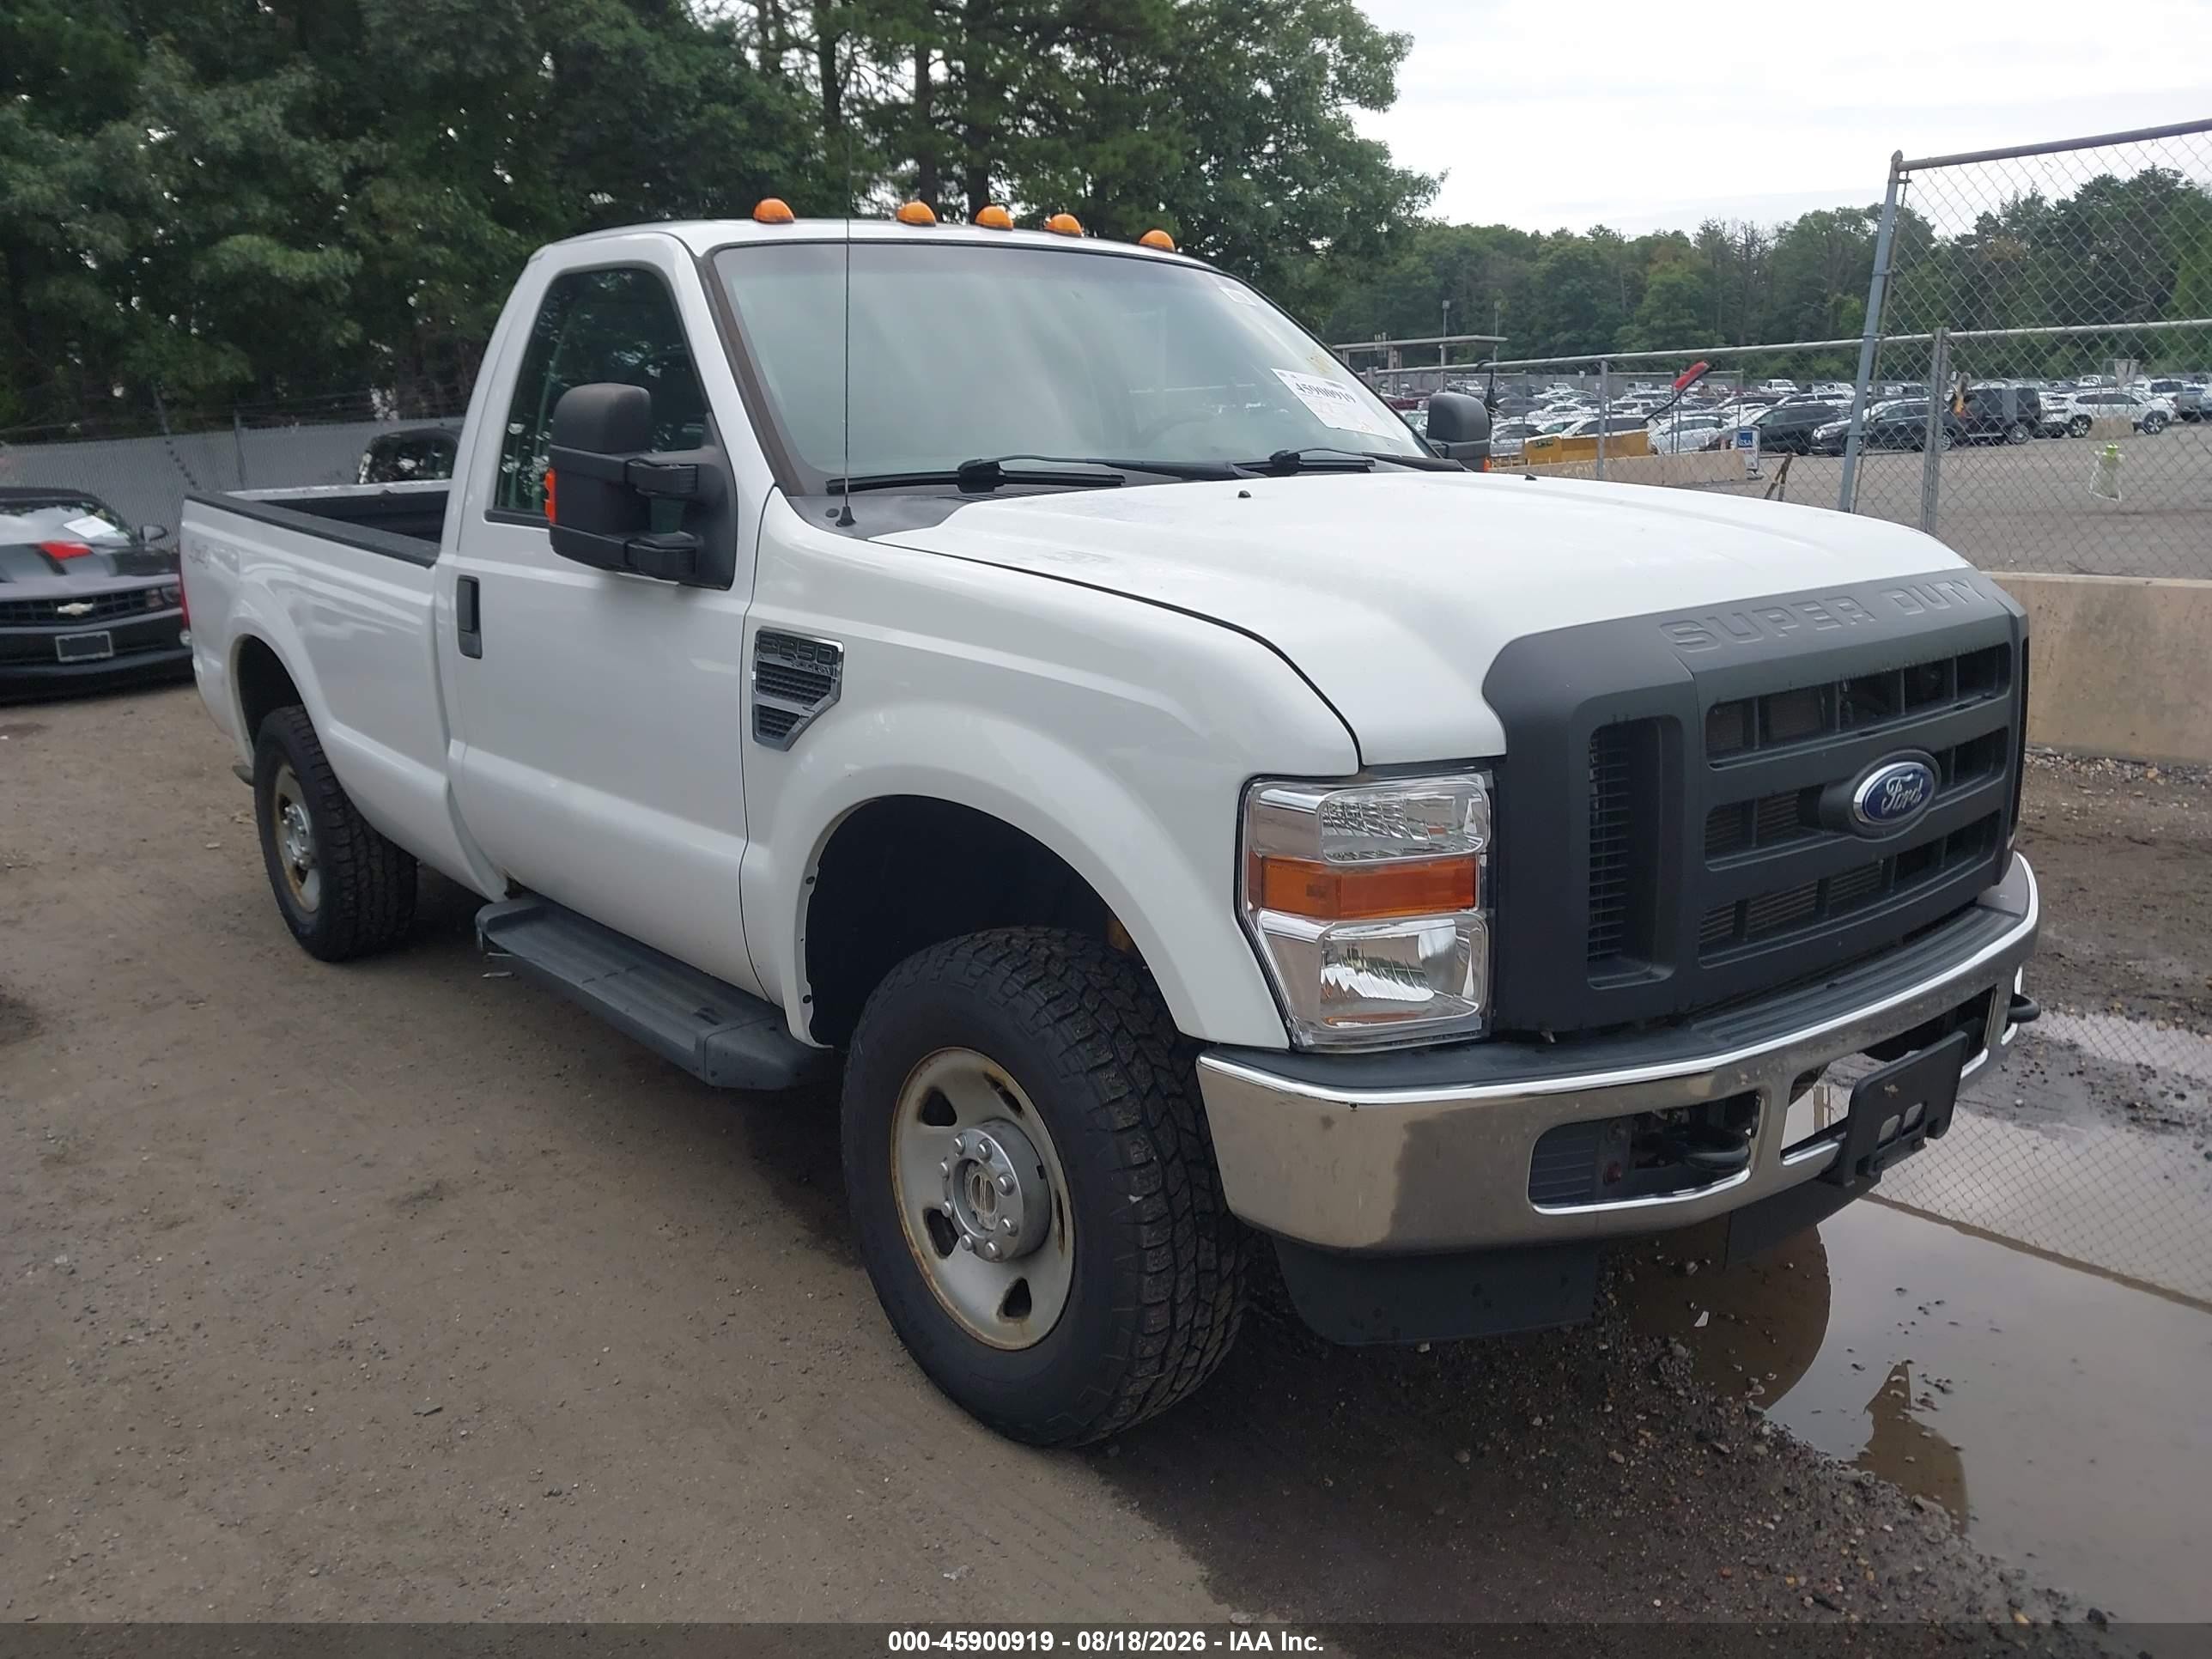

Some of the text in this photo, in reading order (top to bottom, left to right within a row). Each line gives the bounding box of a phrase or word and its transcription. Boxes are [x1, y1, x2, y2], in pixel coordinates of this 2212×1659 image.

[1658, 577, 1988, 653] SUPER DUTY
[1881, 772, 1923, 815] Ford
